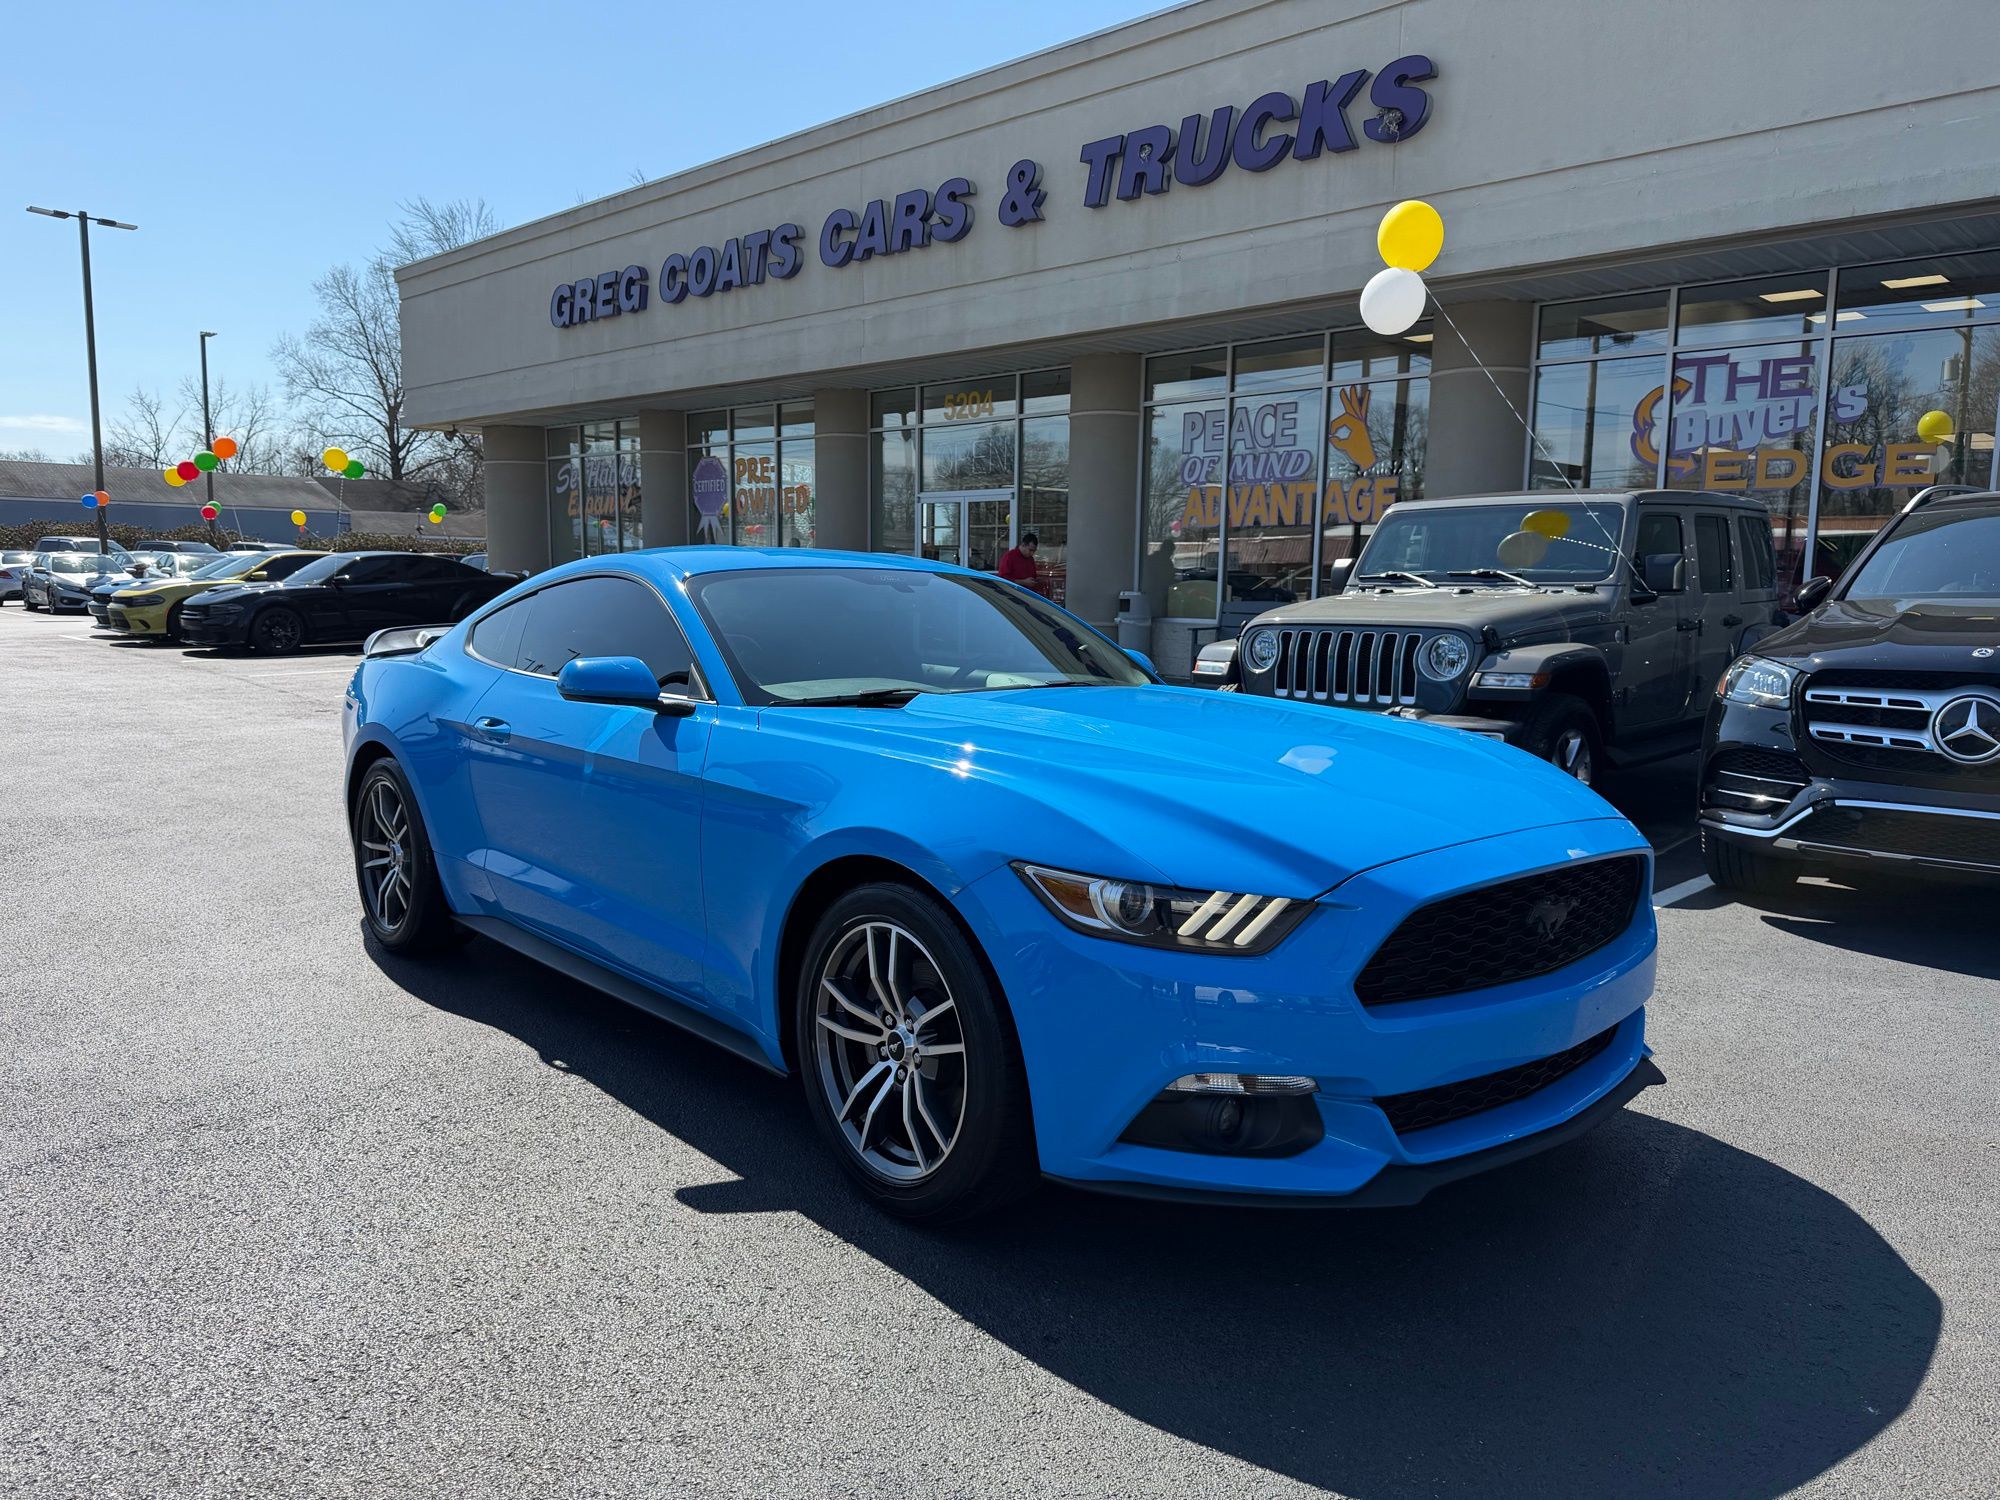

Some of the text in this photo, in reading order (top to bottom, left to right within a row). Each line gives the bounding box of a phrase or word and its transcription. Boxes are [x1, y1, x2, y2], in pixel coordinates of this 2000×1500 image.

[550, 54, 1439, 328] GREG COATS CARS & TRUCKS
[1675, 353, 1816, 405] THE
[943, 389, 994, 421] 5204
[1182, 401, 1299, 454] PEACE
[555, 462, 580, 494] Se
[736, 456, 775, 485] PRE-
[1181, 450, 1313, 484] OF MIND
[1702, 442, 1938, 490] EDGE
[693, 479, 726, 493] CERTIFIED
[736, 486, 809, 516] OWNED
[1181, 476, 1401, 528] ADVANTAGE
[567, 487, 638, 523] Epal
